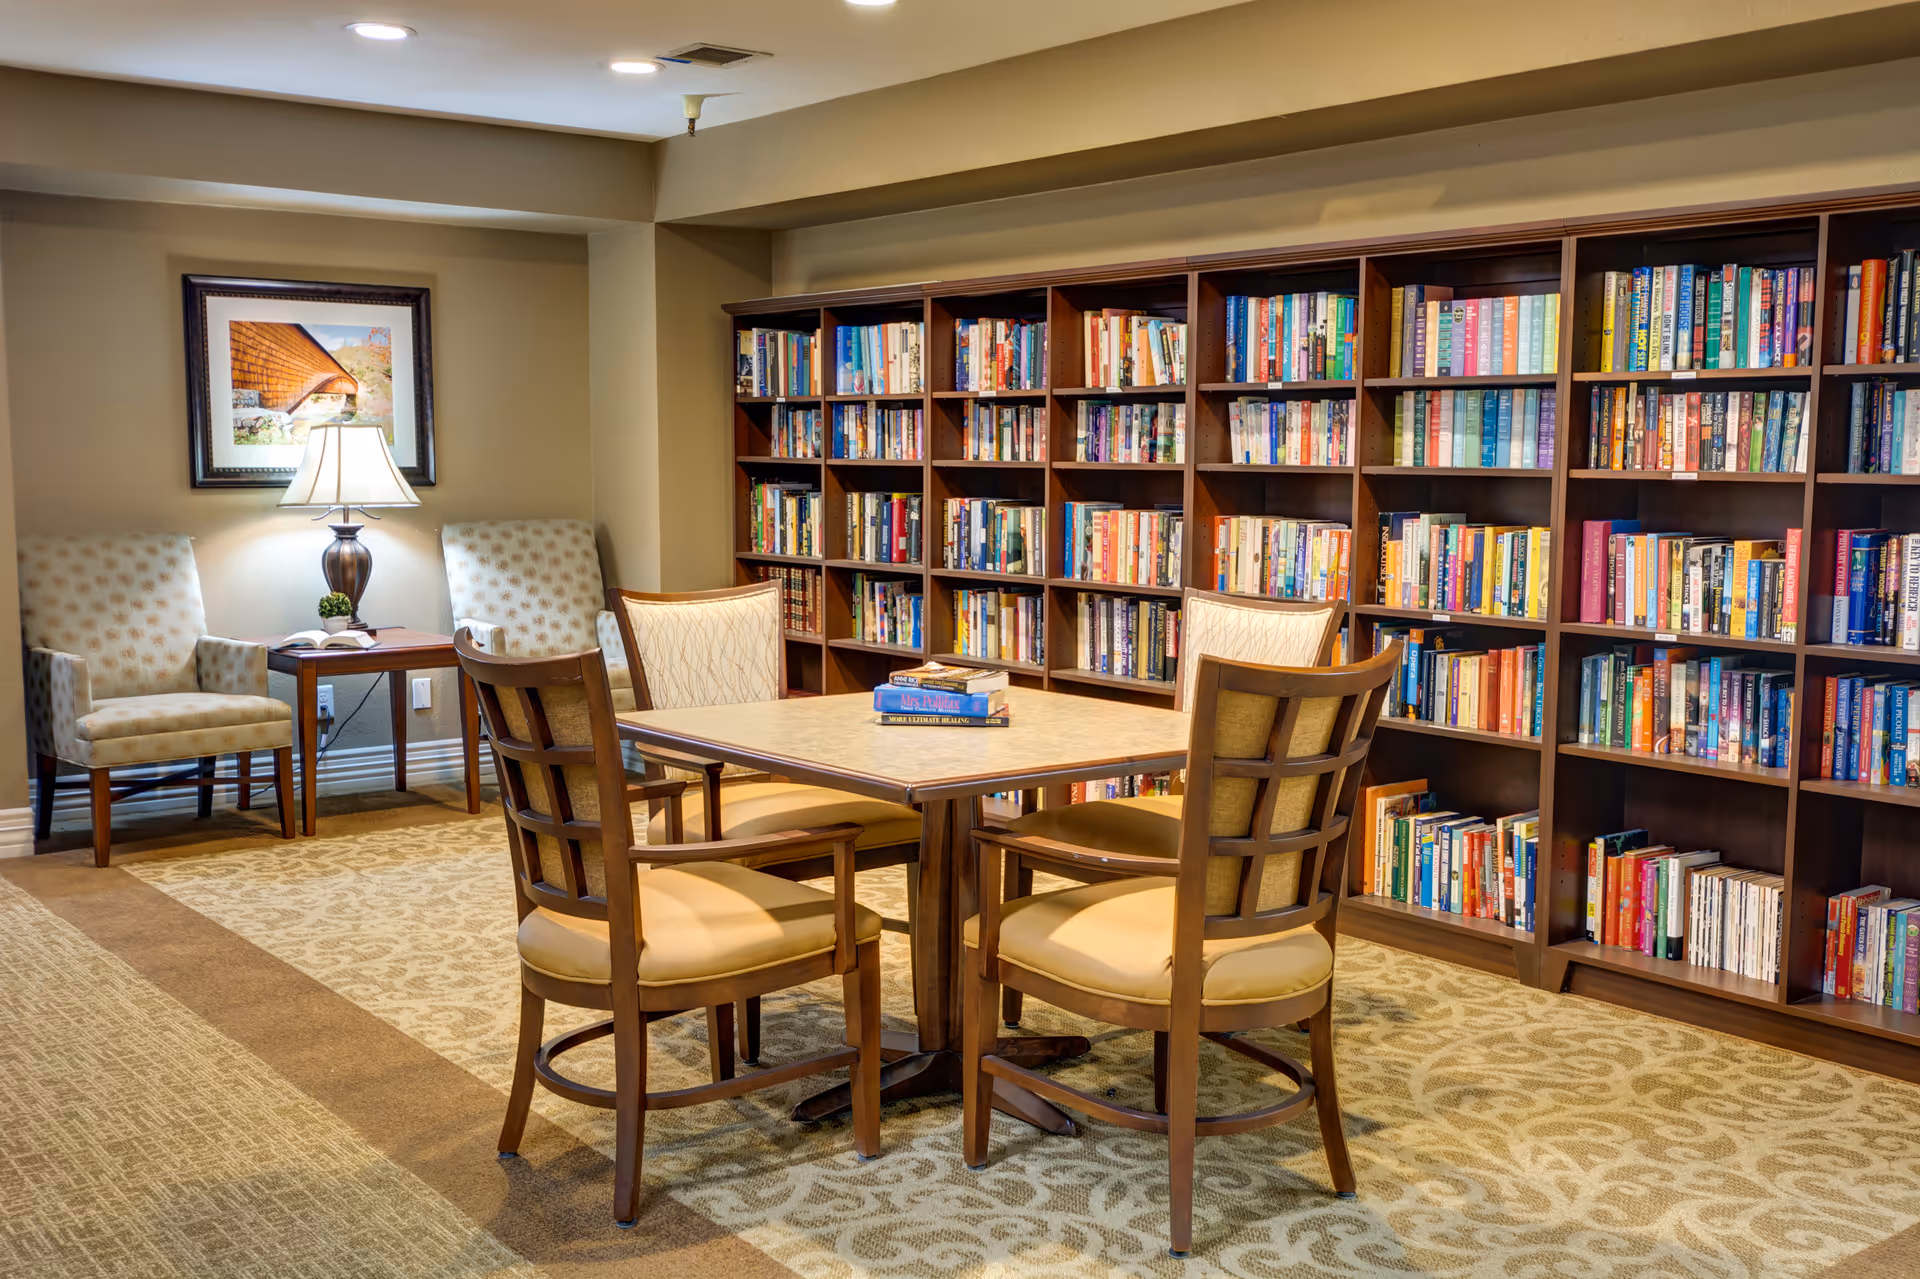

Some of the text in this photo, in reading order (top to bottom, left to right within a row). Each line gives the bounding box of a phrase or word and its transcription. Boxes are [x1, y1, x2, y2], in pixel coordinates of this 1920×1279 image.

[1679, 274, 1692, 330] BEACH HOUSE
[1761, 280, 1772, 310] MIND
[1638, 330, 1647, 351] HOT
[1662, 336, 1671, 355] BLINK
[1637, 352, 1646, 366] SIX
[1786, 545, 1797, 605] DEBBIE MACOMBER
[1835, 533, 1847, 633] PRIMARY COLORS ANONYMOUS
[1908, 546, 1920, 612] KEY TO REBECCA
[901, 694, 960, 709] Mrs Pollifax
